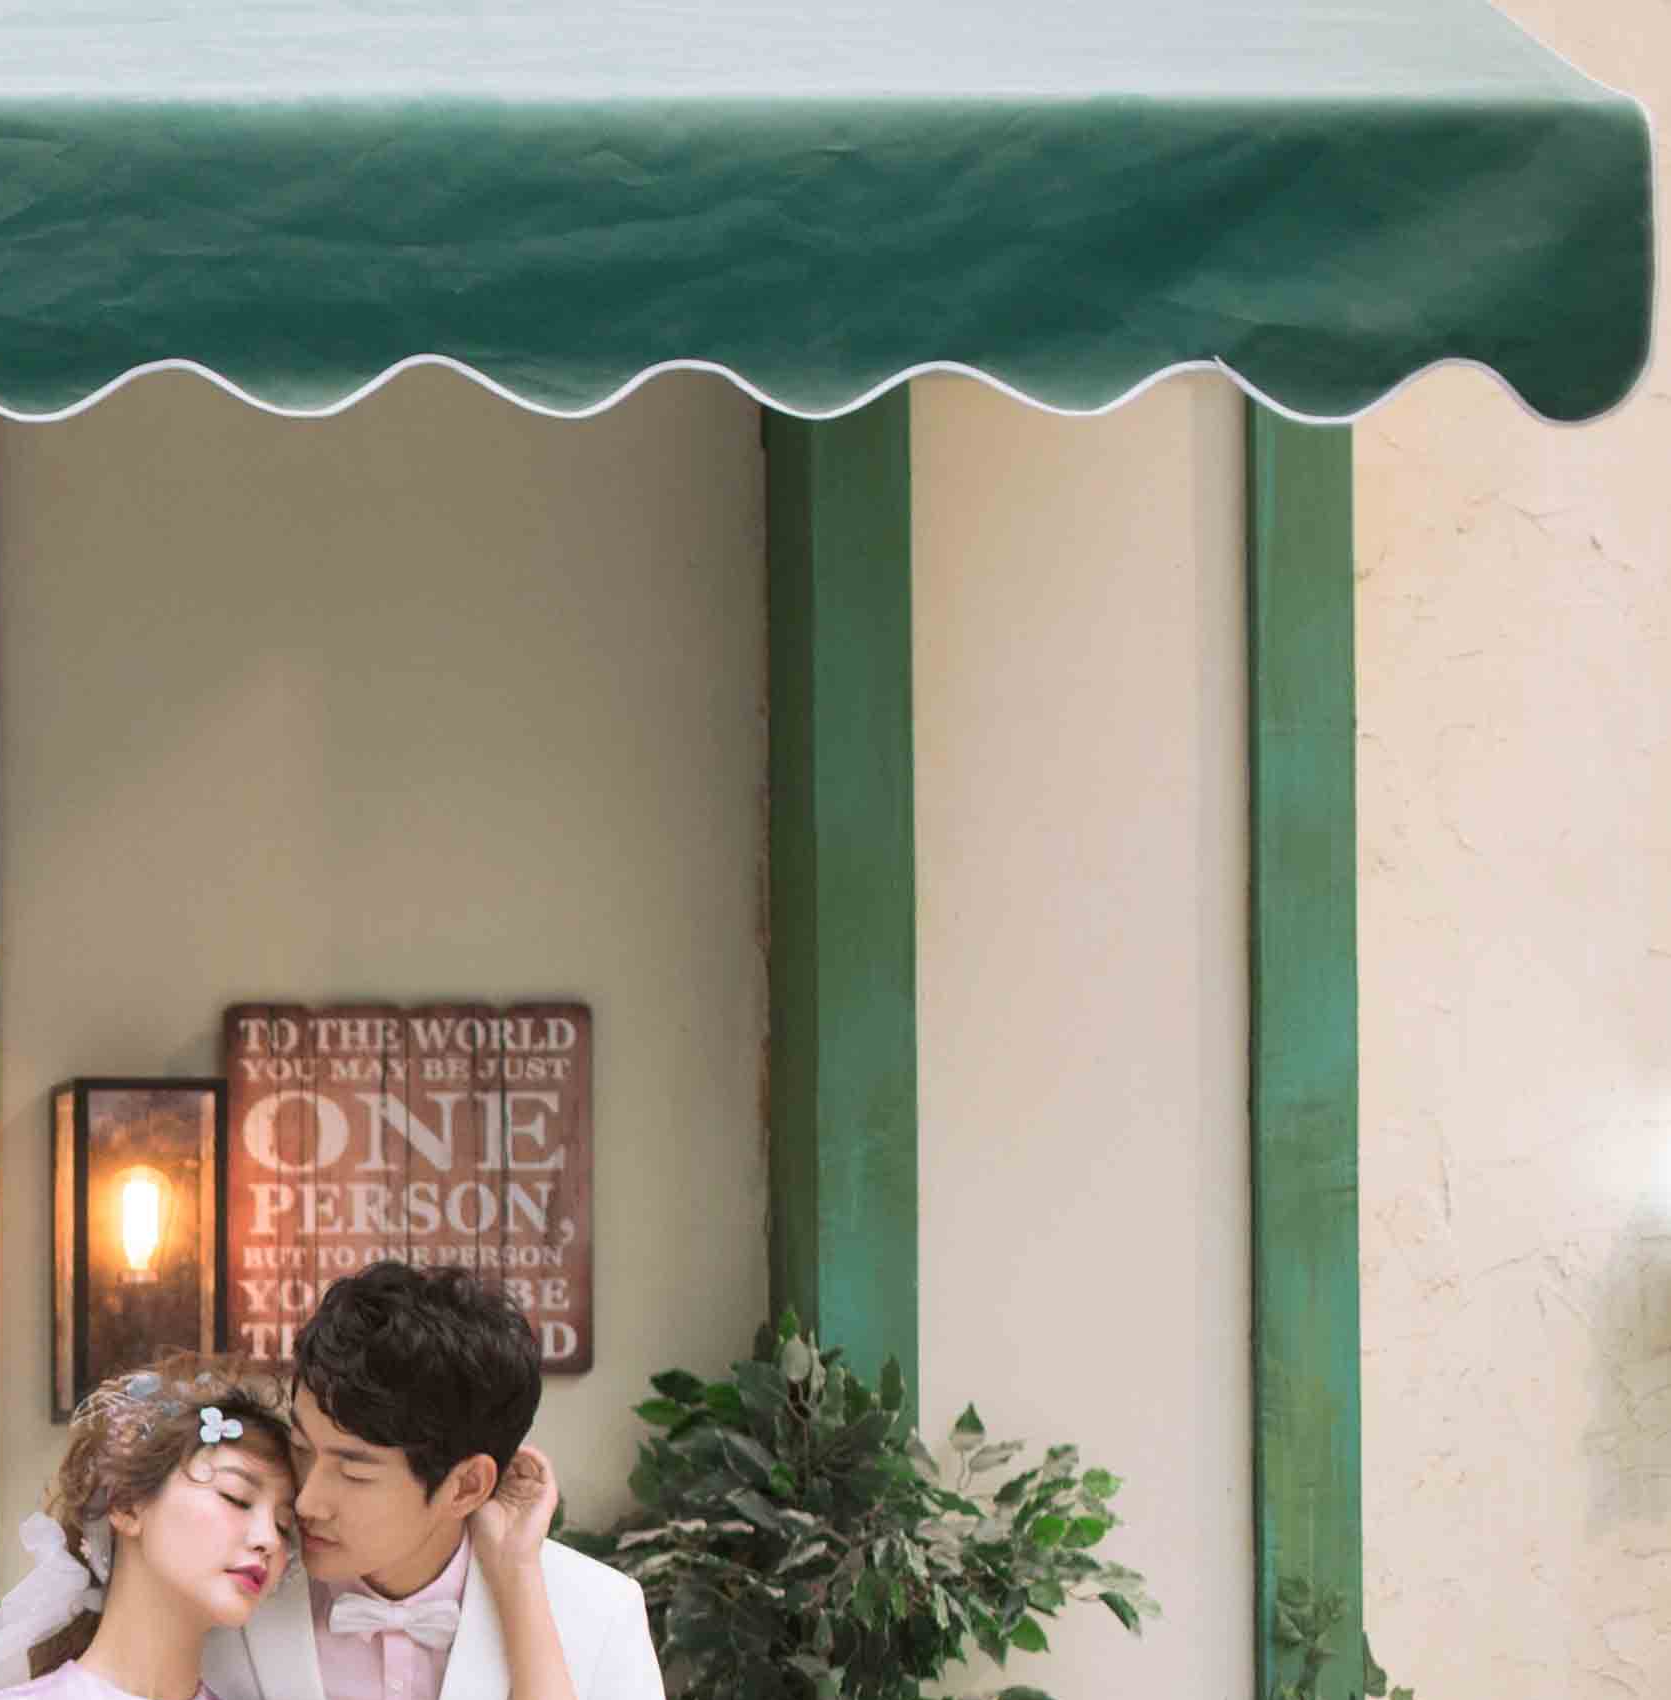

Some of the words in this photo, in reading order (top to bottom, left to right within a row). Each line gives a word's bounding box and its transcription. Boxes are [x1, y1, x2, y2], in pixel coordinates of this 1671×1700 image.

[239, 1018, 299, 1052] TO
[309, 1017, 402, 1053] THE
[410, 1016, 576, 1052] WORLD
[242, 1058, 317, 1082] YOU
[330, 1057, 409, 1082] MAY
[423, 1058, 471, 1082] BE
[477, 1058, 572, 1082] JUST
[242, 1089, 566, 1174] ONE
[248, 1180, 575, 1246] PERSON,
[242, 1246, 307, 1269] BUT
[315, 1246, 356, 1269] TO
[363, 1246, 433, 1269] ONE
[438, 1246, 565, 1269] PERSON
[239, 1278, 329, 1312] YO
